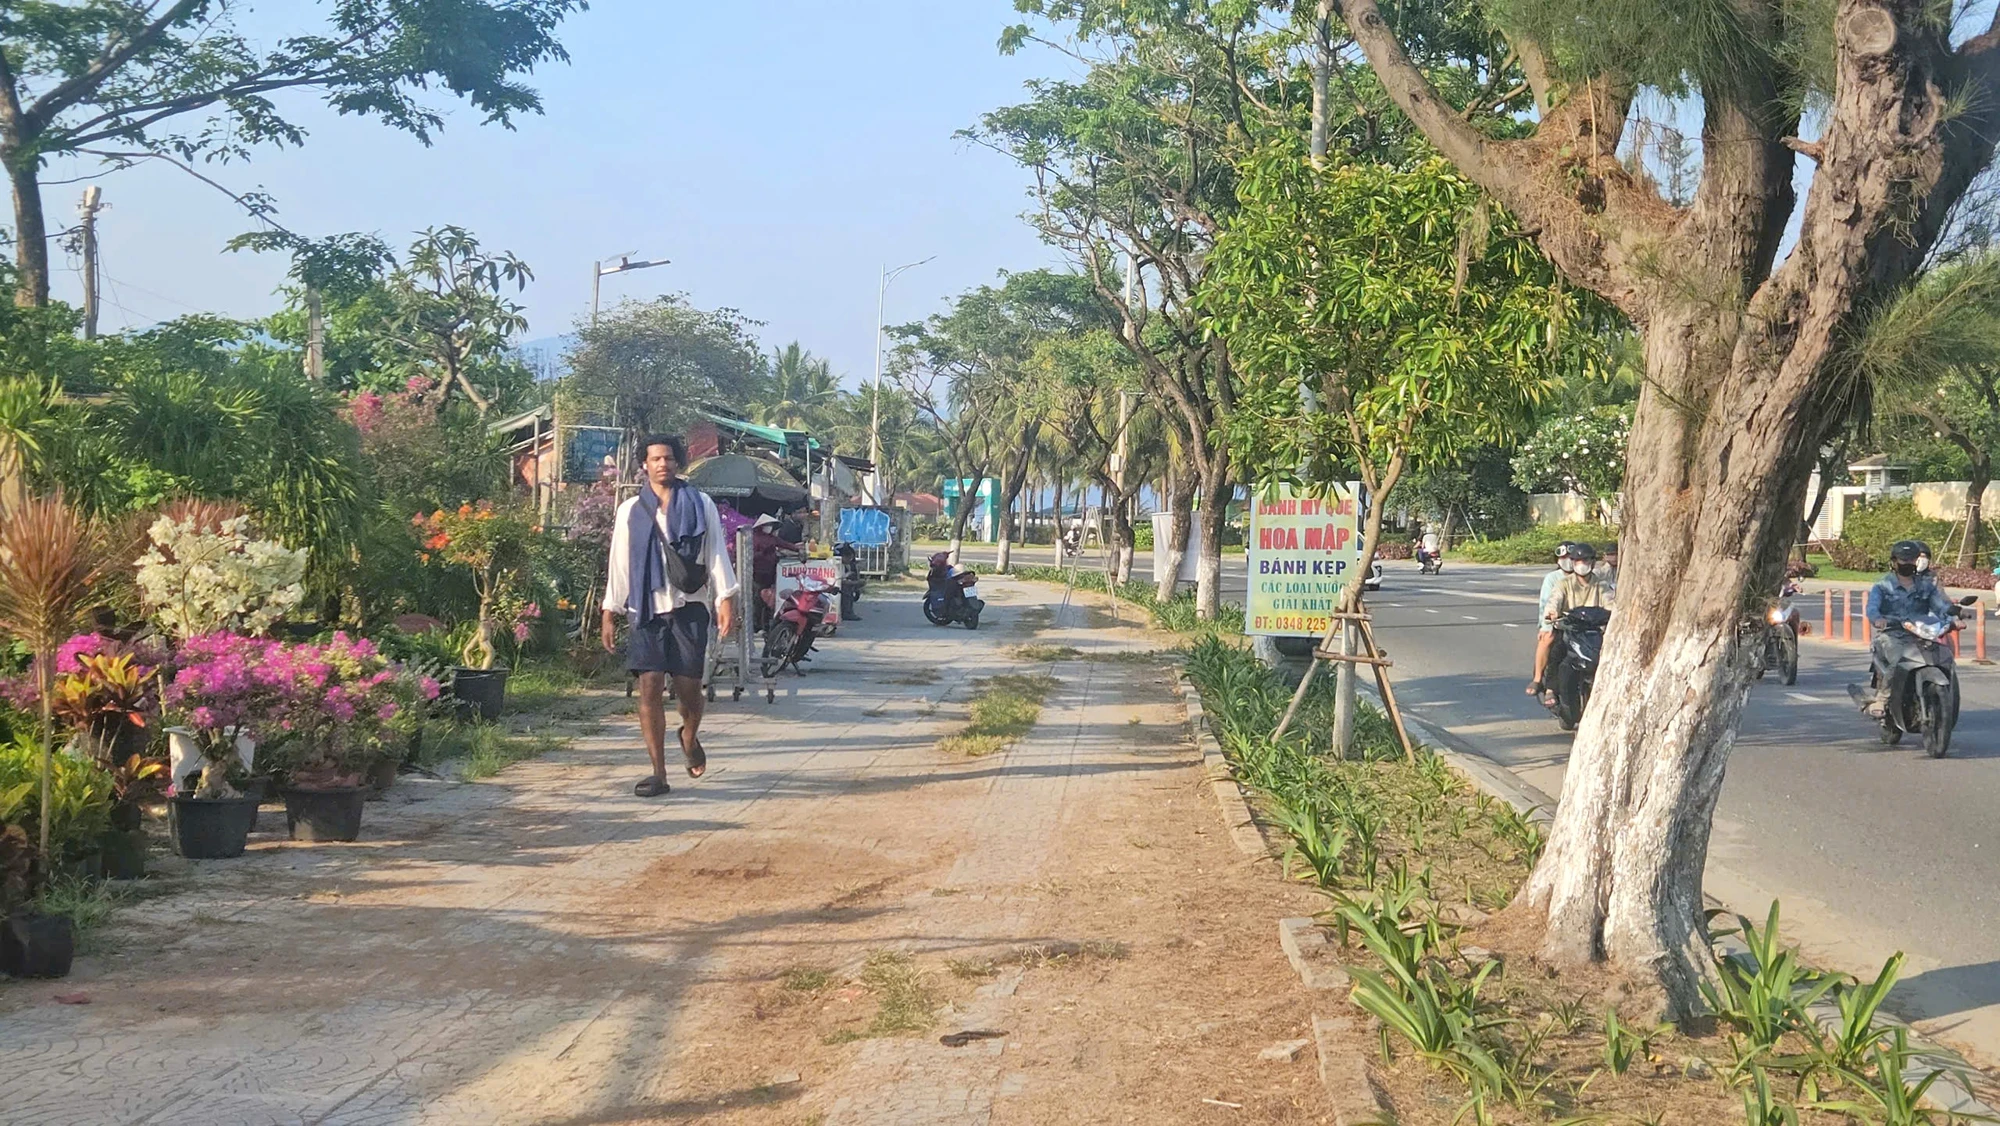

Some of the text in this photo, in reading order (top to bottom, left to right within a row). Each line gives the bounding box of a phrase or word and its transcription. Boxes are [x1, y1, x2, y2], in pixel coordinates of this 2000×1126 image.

[1259, 523, 1350, 555] HOA MẬP
[1259, 557, 1347, 578] BÁNH KẸP
[1261, 580, 1282, 593] CÁC
[1286, 582, 1311, 596] LOẠI
[1255, 616, 1272, 629] ĐT:
[1276, 617, 1303, 630] 0348
[1306, 617, 1327, 631] 225
